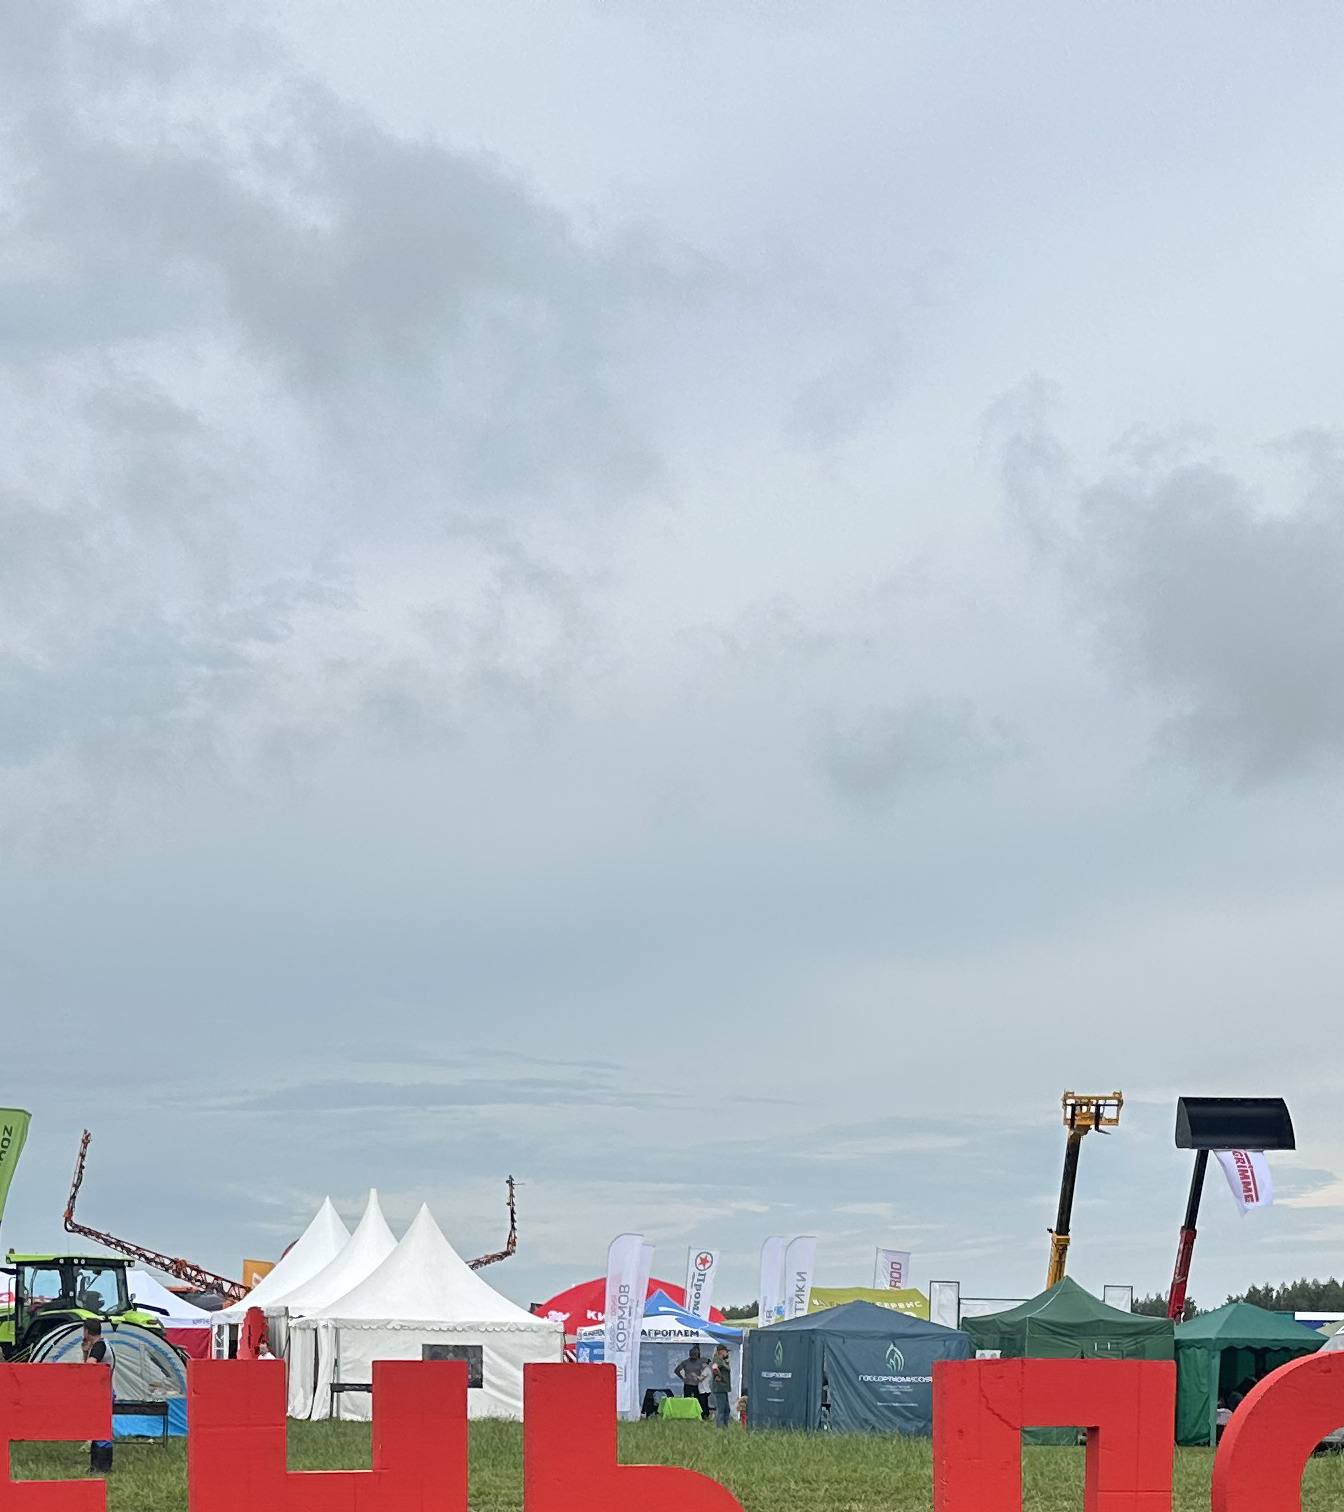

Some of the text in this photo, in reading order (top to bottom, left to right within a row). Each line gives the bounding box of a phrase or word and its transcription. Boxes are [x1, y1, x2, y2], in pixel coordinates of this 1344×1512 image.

[1232, 1151, 1254, 1203] GRIMME
[794, 1272, 807, 1315] ТИКИ
[616, 1284, 630, 1352] КОРМОВ
[640, 1329, 700, 1338] АГРОПЛЕМ
